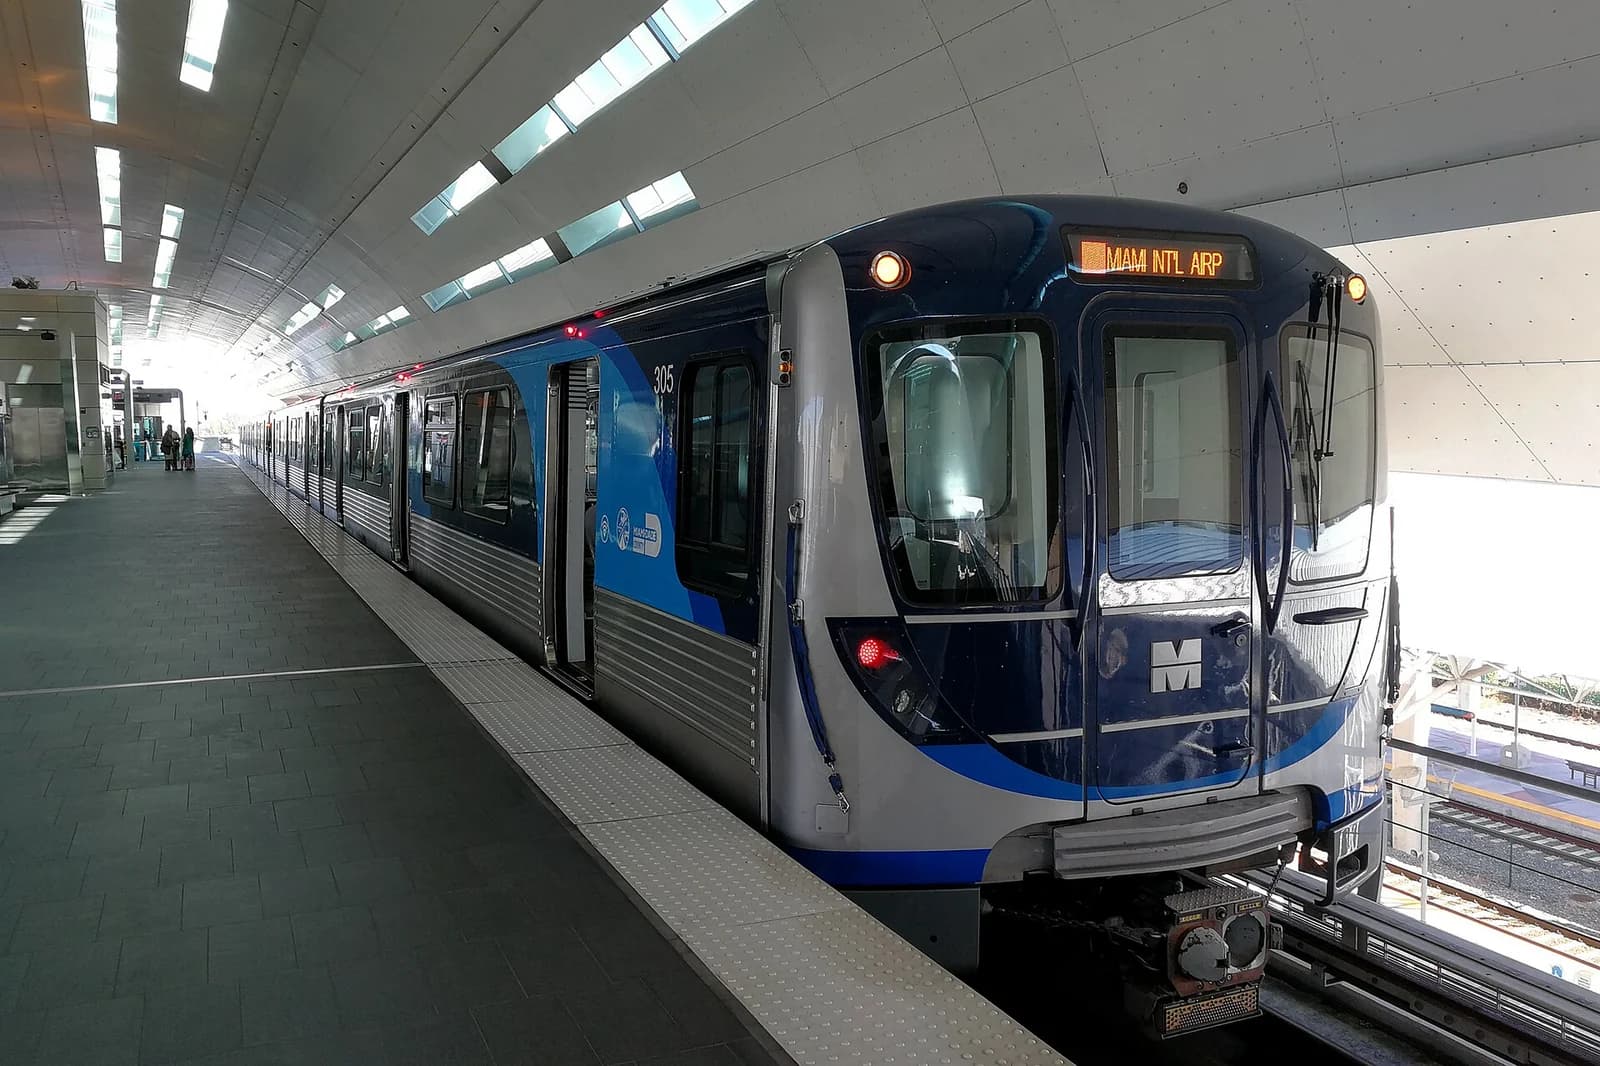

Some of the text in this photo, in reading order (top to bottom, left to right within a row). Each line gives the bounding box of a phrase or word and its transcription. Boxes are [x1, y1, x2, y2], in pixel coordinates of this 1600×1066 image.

[1107, 246, 1223, 276] MIAMI INT'L AIRP
[653, 364, 674, 394] 305
[1150, 638, 1201, 693] M
